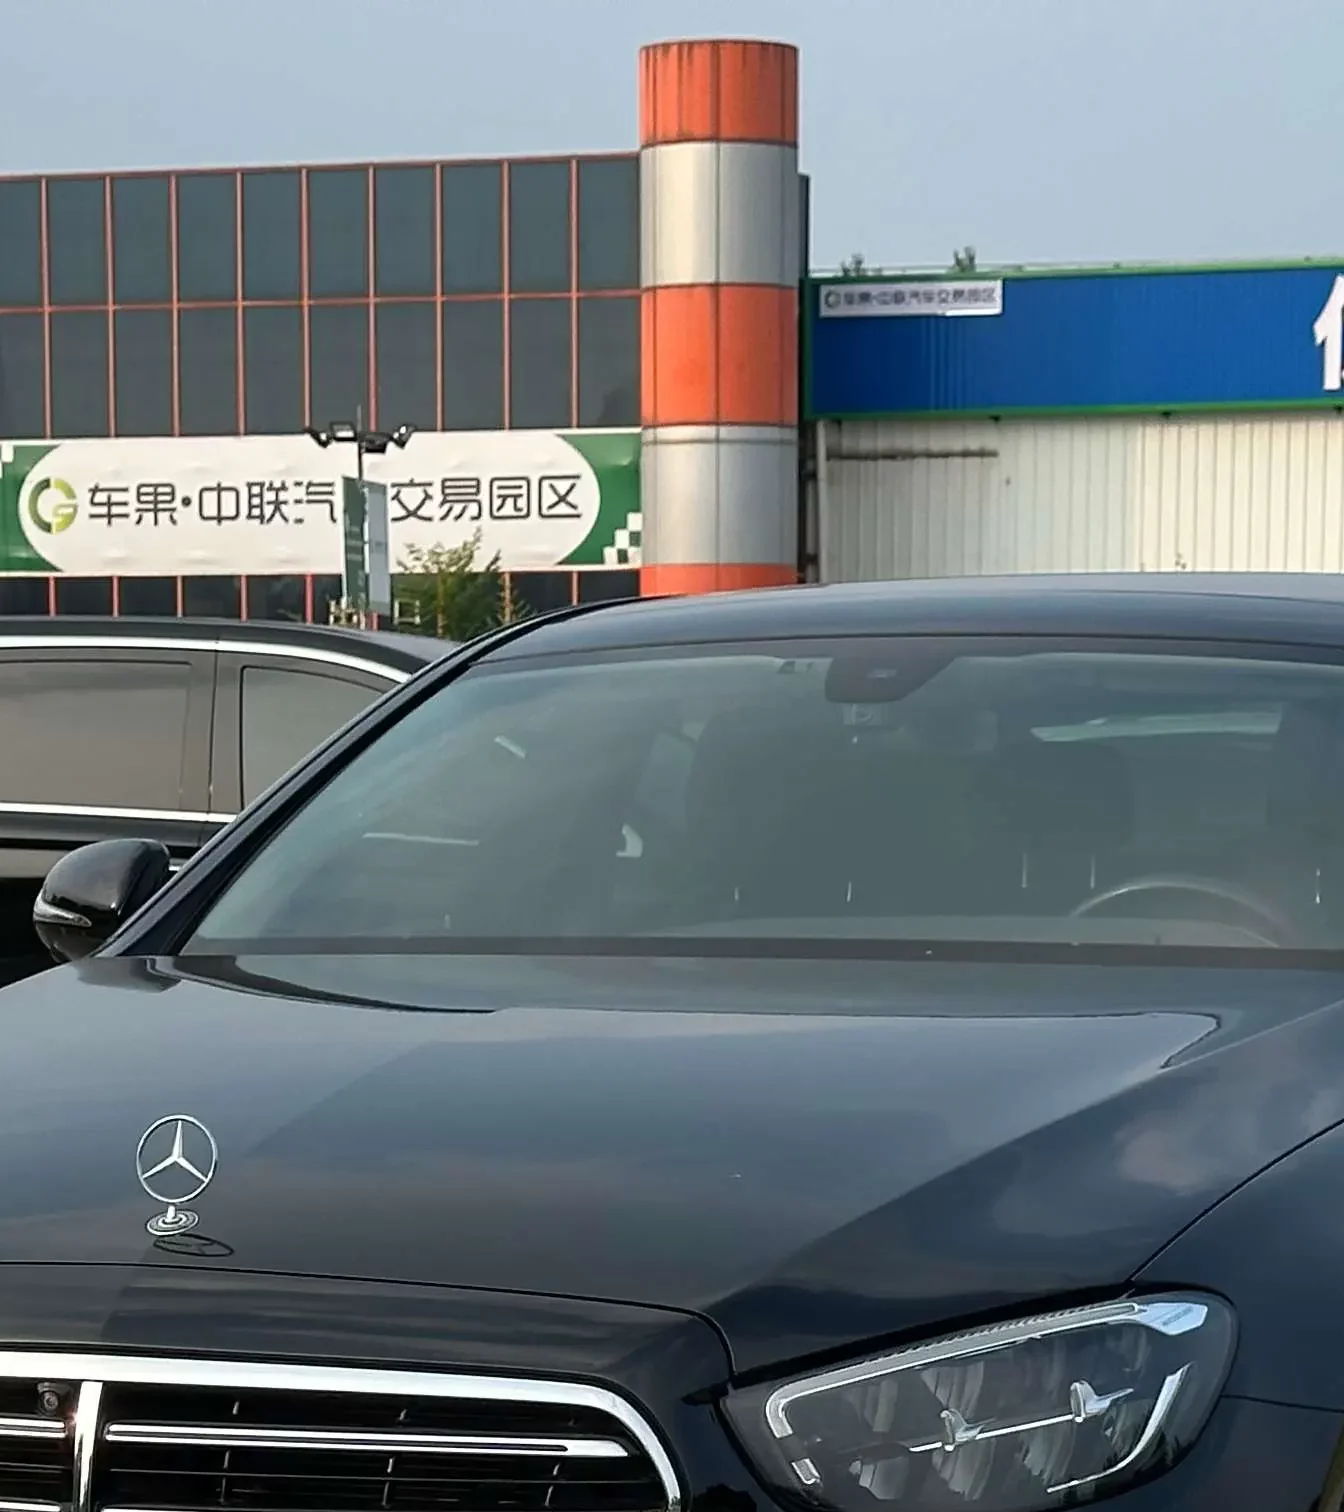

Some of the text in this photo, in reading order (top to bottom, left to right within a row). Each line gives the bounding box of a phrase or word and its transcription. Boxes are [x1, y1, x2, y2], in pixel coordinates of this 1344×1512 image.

[87, 474, 583, 528] 车果·中联汽交易园区
